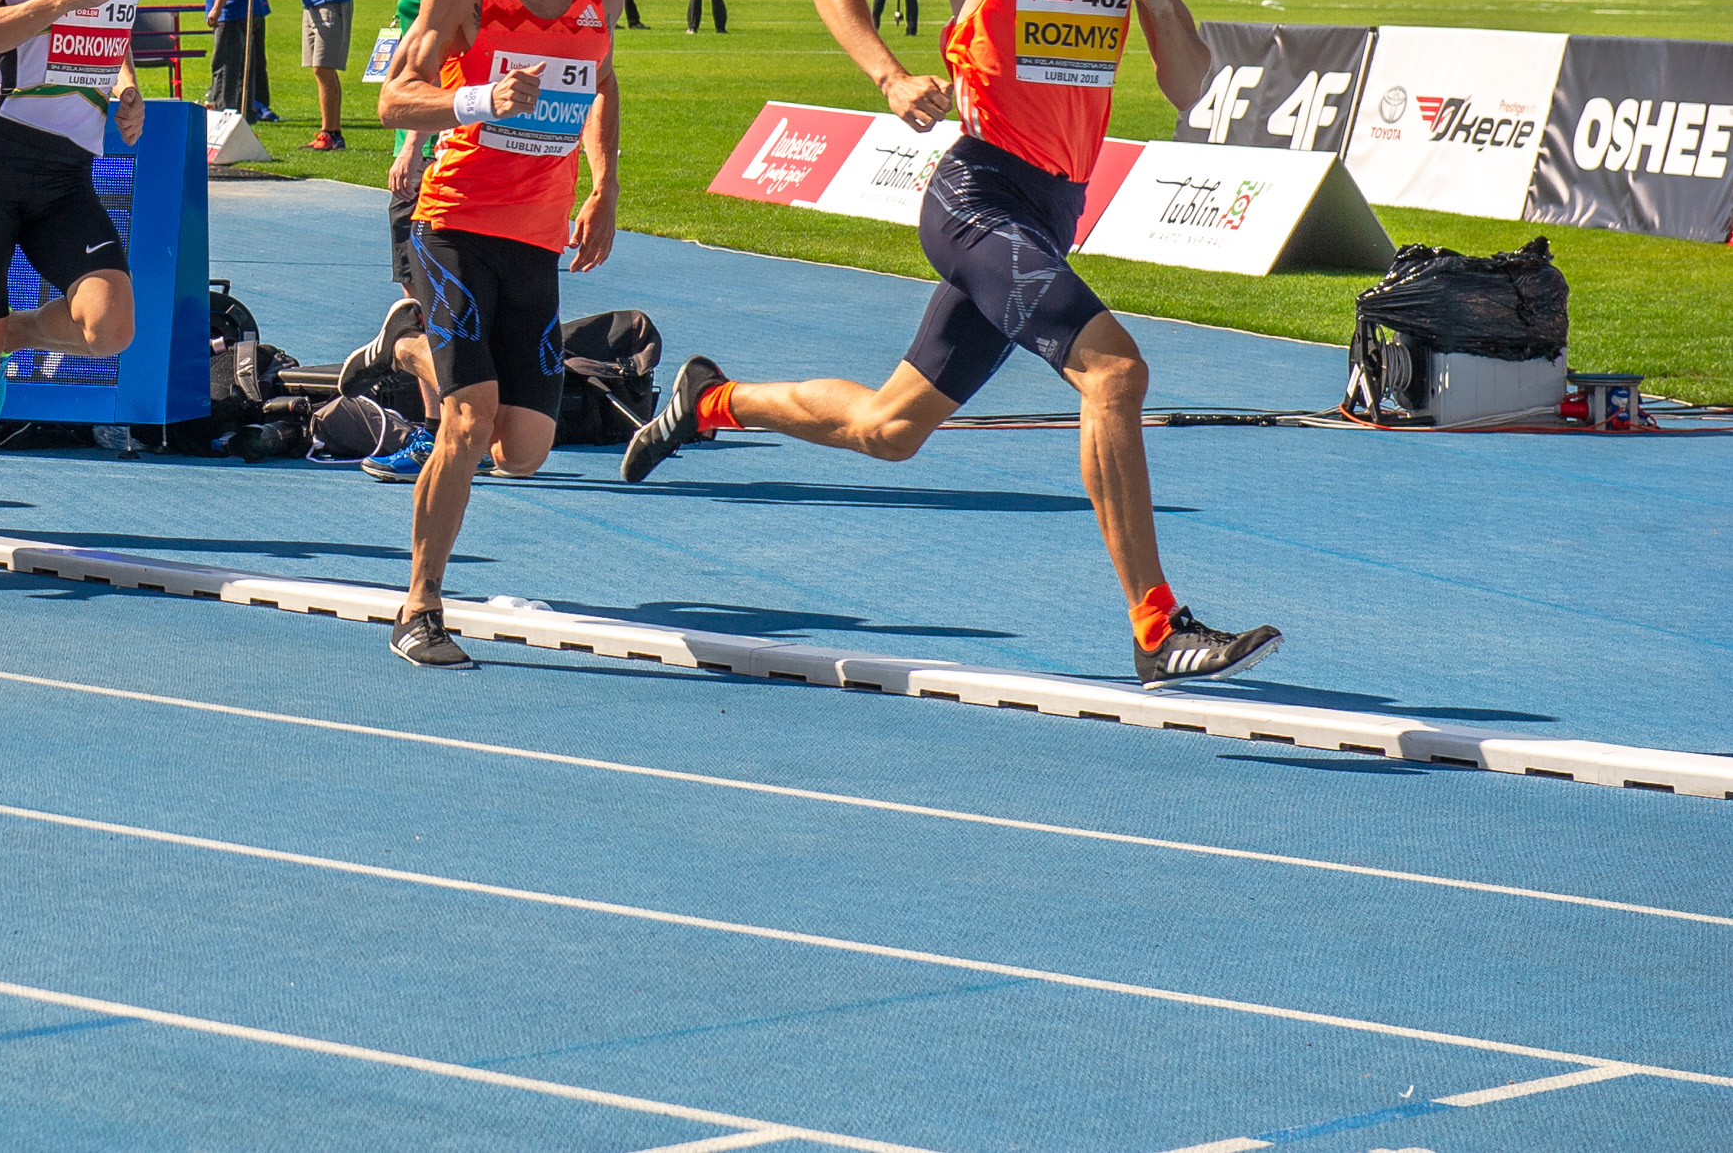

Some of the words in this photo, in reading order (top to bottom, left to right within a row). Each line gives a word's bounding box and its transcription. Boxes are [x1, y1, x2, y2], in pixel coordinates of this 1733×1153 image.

[105, 3, 135, 22] 150
[576, 18, 603, 28] adidas
[52, 33, 130, 57] BORKOWSKI
[1024, 21, 1119, 50] ROZMYS
[69, 75, 97, 85] LUBLIN
[561, 65, 588, 87] 51
[1044, 71, 1079, 83] LUBLIN
[1080, 74, 1100, 84] 2018
[1188, 65, 1264, 144] 4F
[1267, 70, 1353, 151] 4F
[1370, 127, 1402, 140] TOYOTA
[1573, 97, 1733, 179] OSHEE
[505, 139, 542, 152] LUBLIN
[543, 145, 564, 154] 2018
[771, 131, 828, 163] lubelskie
[871, 146, 919, 190] lublin
[1156, 176, 1222, 227] lublin
